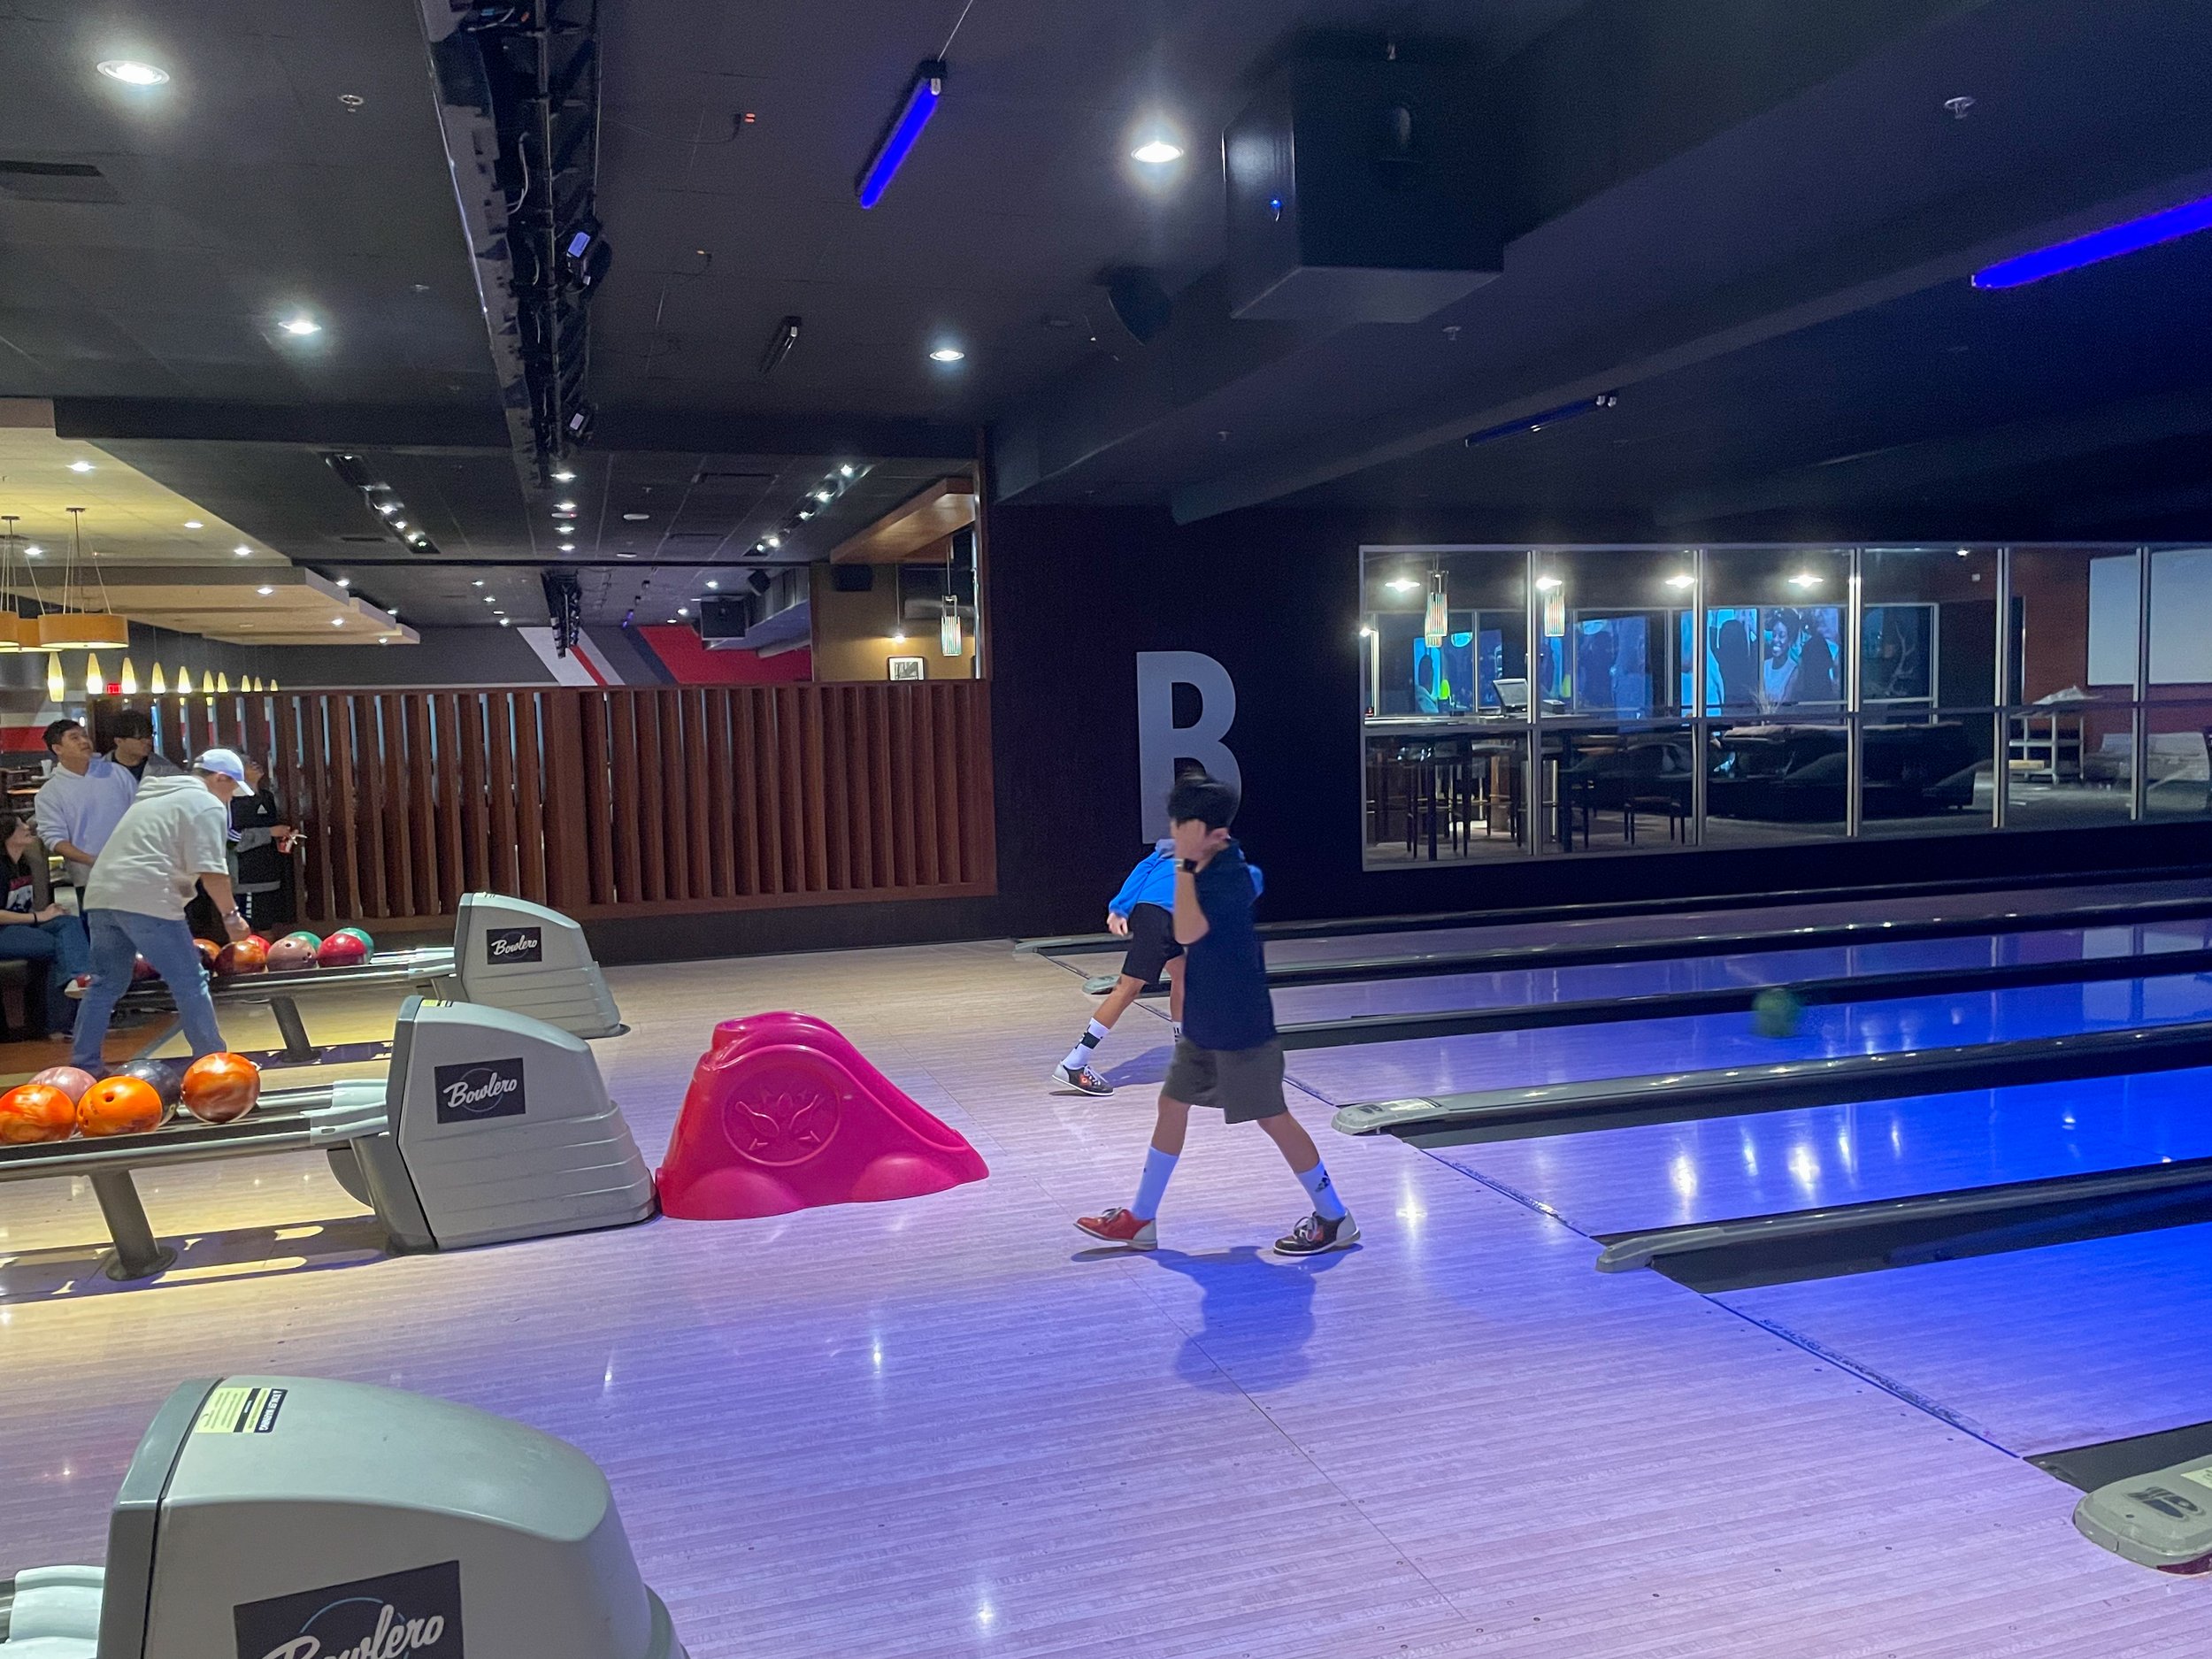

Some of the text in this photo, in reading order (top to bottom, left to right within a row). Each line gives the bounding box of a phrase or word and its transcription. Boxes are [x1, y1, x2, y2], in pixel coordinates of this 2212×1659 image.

[1136, 650, 1242, 844] B
[491, 934, 538, 956] Bowlero
[442, 1071, 518, 1108] Bowlero
[262, 1603, 445, 1659] wlero
